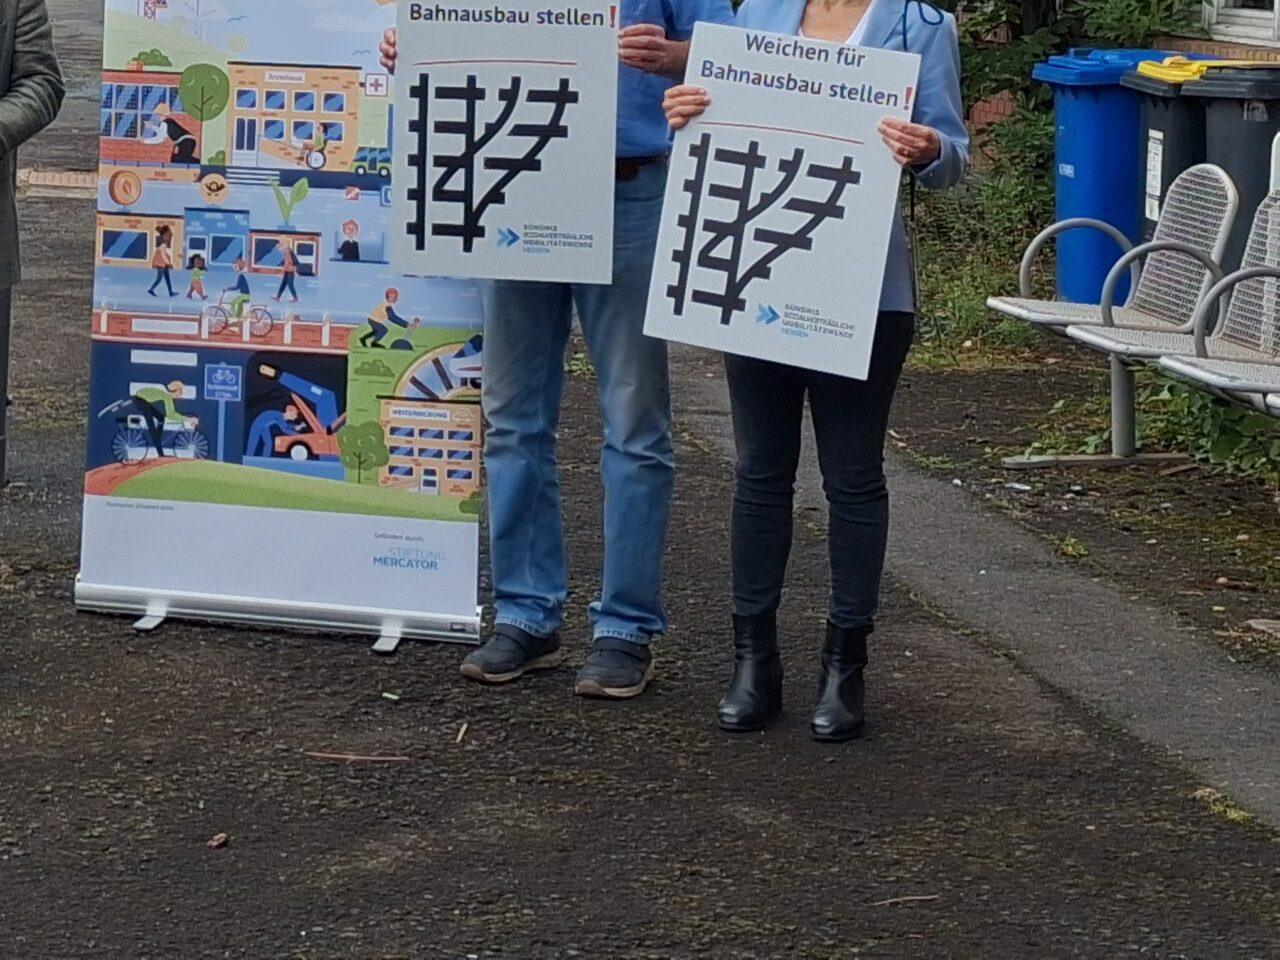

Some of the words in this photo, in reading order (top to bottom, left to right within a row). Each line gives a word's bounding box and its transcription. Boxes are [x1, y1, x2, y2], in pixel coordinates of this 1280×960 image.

[409, 4, 530, 25] Bahnausbau
[745, 32, 831, 62] Weichen
[835, 46, 867, 68] für
[700, 59, 822, 96] Bahnausbau
[373, 556, 438, 570] MERCATOR
[388, 547, 447, 561] STIFTUNG
